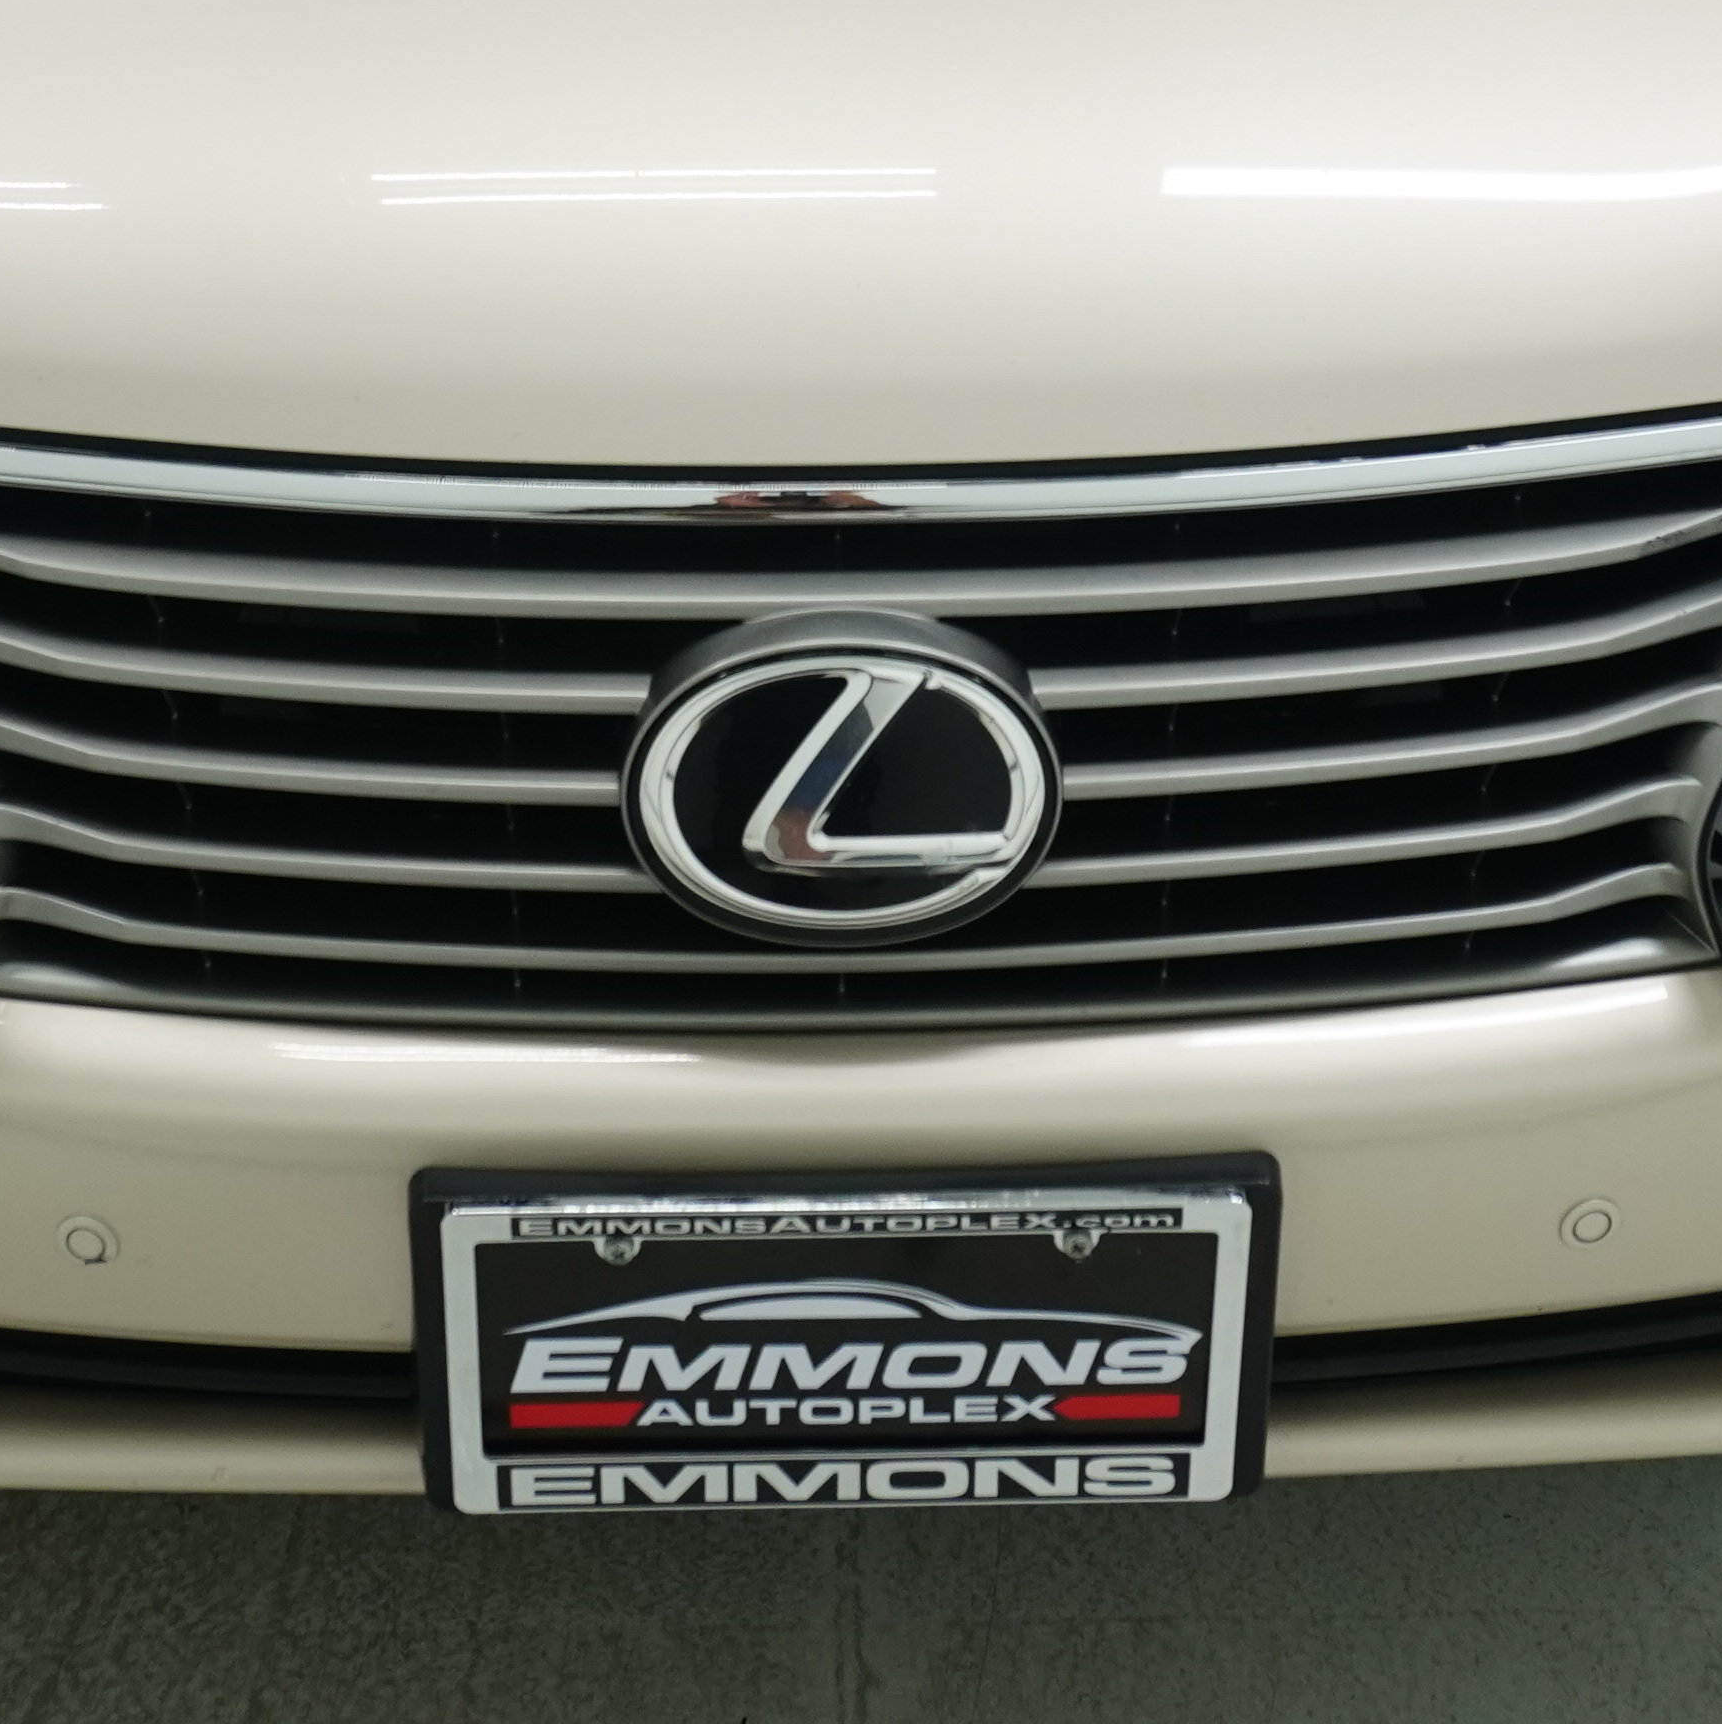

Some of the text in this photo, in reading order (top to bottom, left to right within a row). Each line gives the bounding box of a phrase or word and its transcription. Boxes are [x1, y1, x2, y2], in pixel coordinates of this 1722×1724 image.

[509, 1337, 1189, 1394] EMMONS
[636, 1395, 1058, 1427] AUTOPLEX
[509, 1455, 1177, 1507] EMMONS
